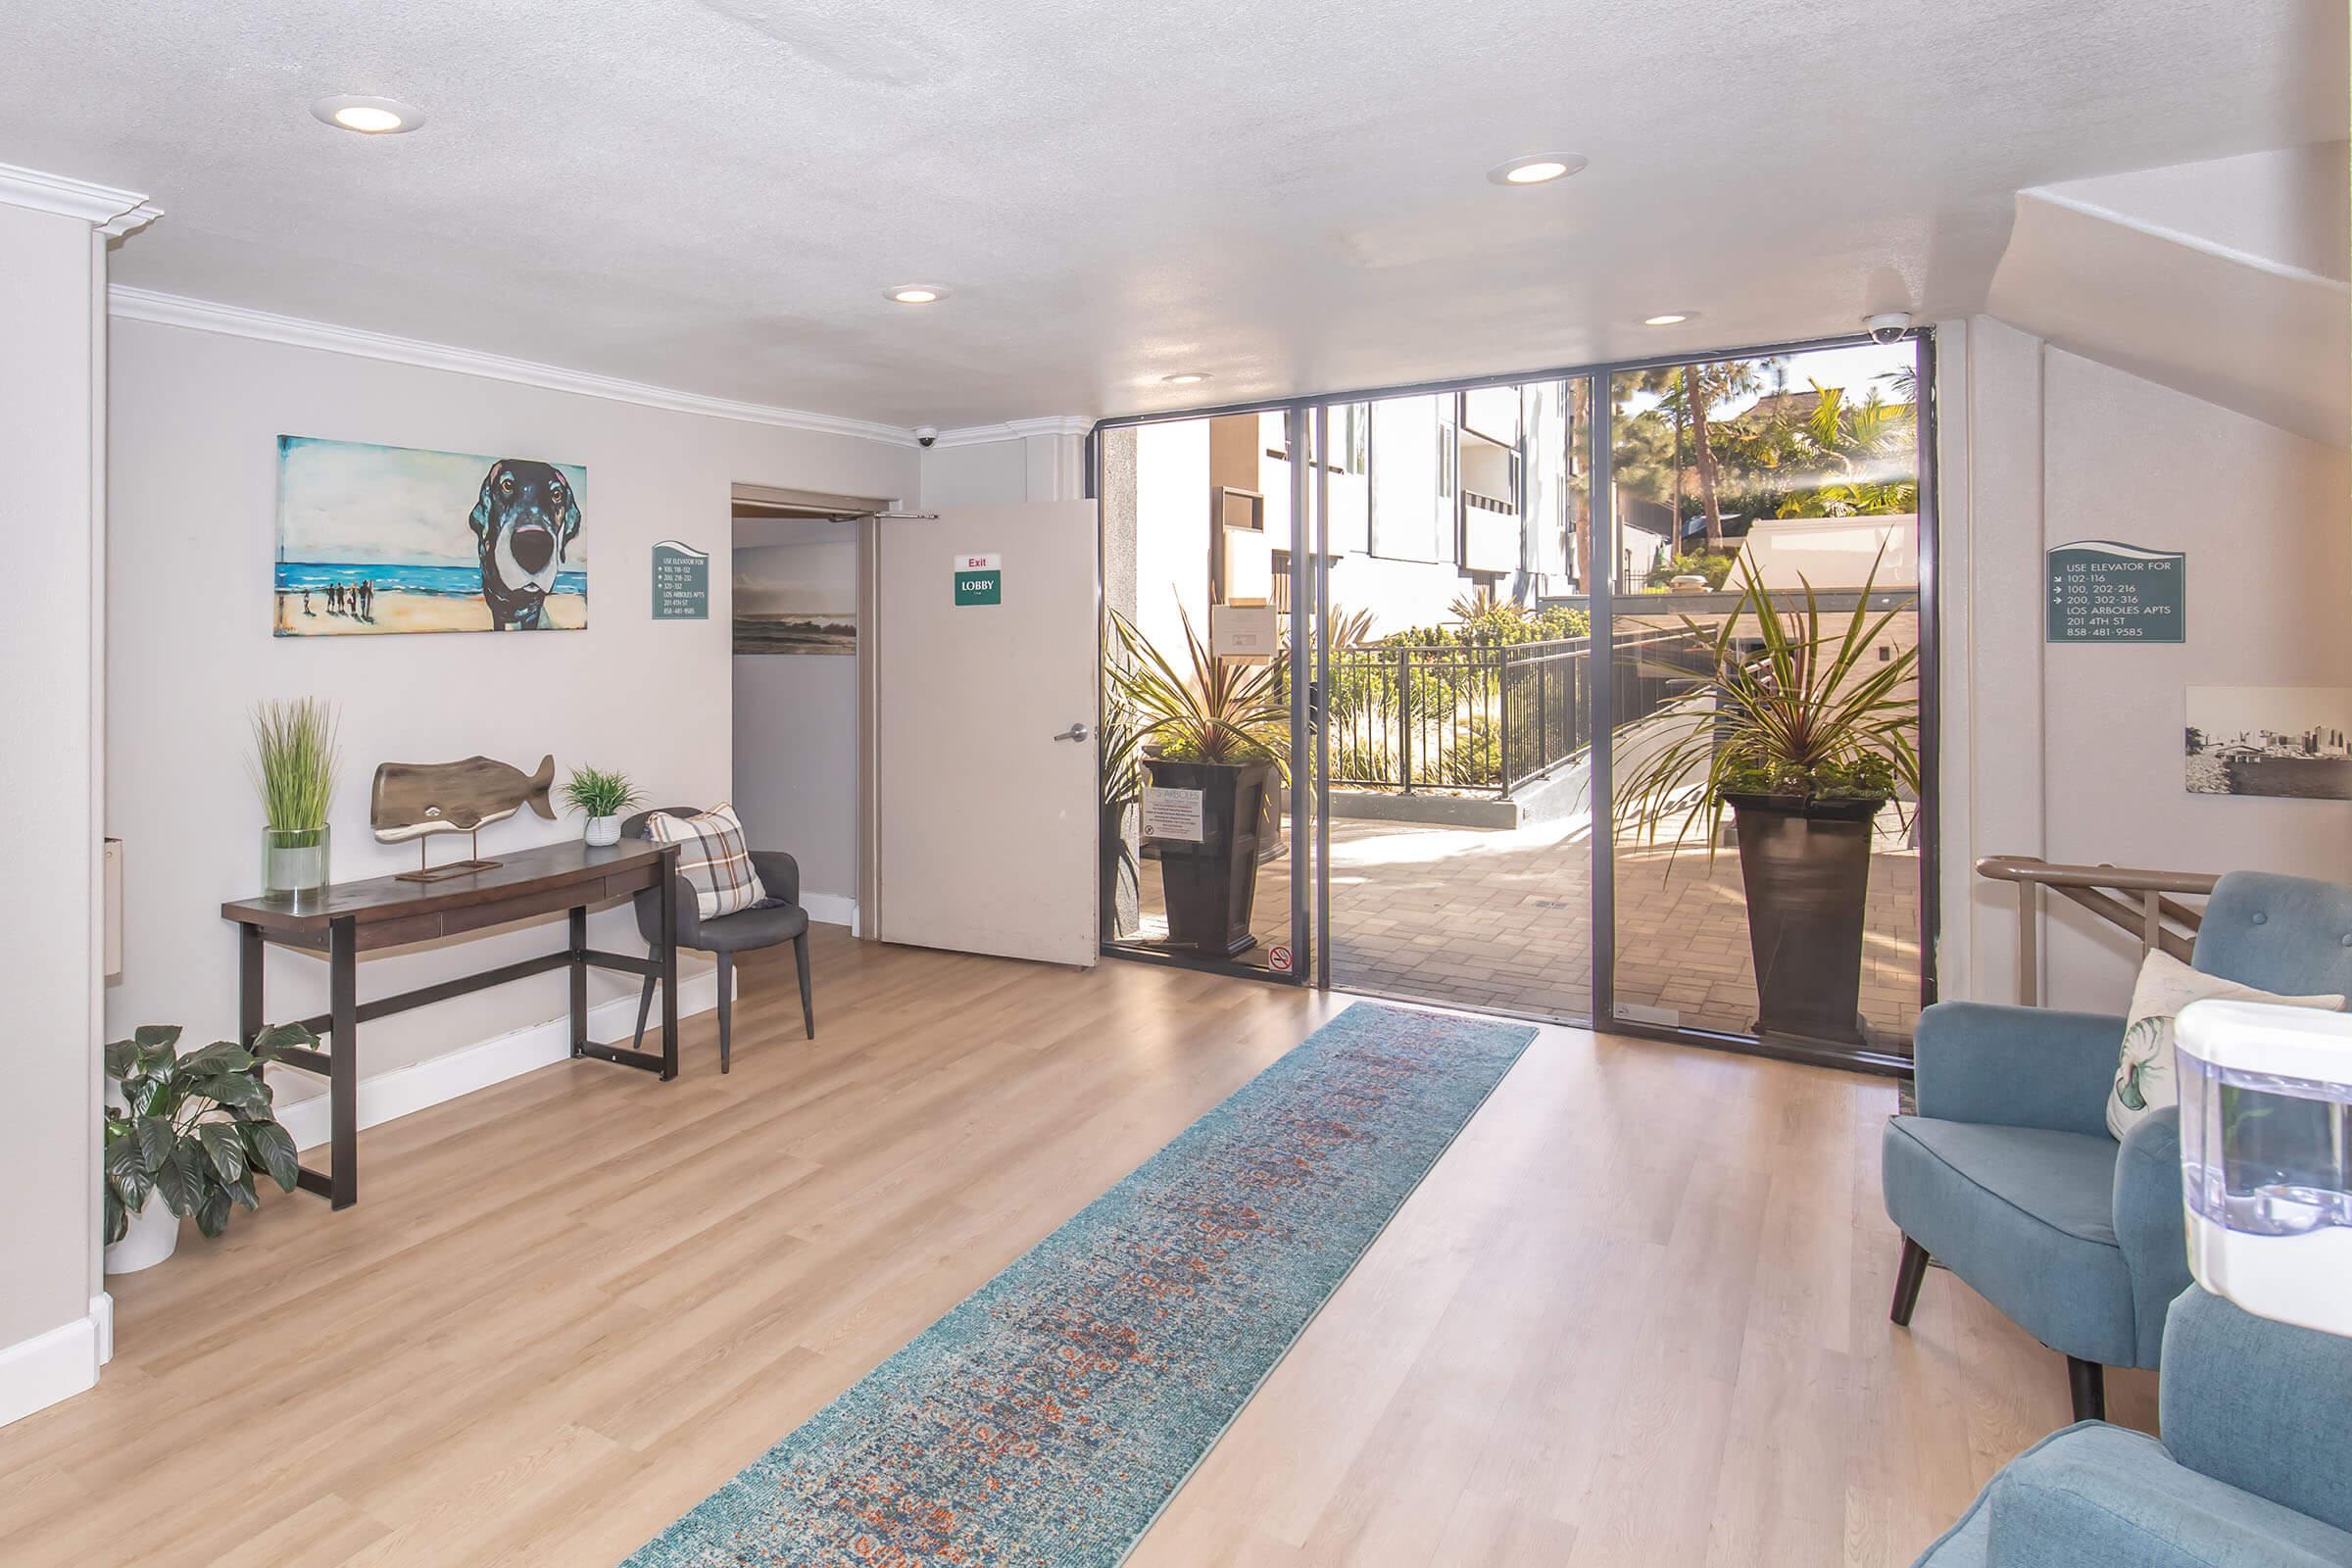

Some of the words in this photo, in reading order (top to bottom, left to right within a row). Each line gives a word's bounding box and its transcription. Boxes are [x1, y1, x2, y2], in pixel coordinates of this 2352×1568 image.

[968, 558, 986, 567] Exit
[2067, 564, 2086, 572] USE
[2091, 563, 2144, 571] ELEVATOR
[2148, 562, 2172, 570] FOR
[2068, 574, 2106, 583] 102-116
[961, 580, 995, 591] LOBBY
[2068, 585, 2088, 594] 100,
[2093, 585, 2136, 593] 202-216
[2068, 596, 2090, 605] 200,
[2095, 595, 2138, 604] 302-316
[2067, 607, 2087, 615] LOS
[2091, 606, 2140, 615] ARBOLES
[2143, 606, 2171, 614] APTS
[2067, 617, 2084, 626] 201
[2089, 617, 2109, 625] 4TH
[2113, 617, 2126, 625] ST
[2067, 628, 2143, 636] 858-481-9585
